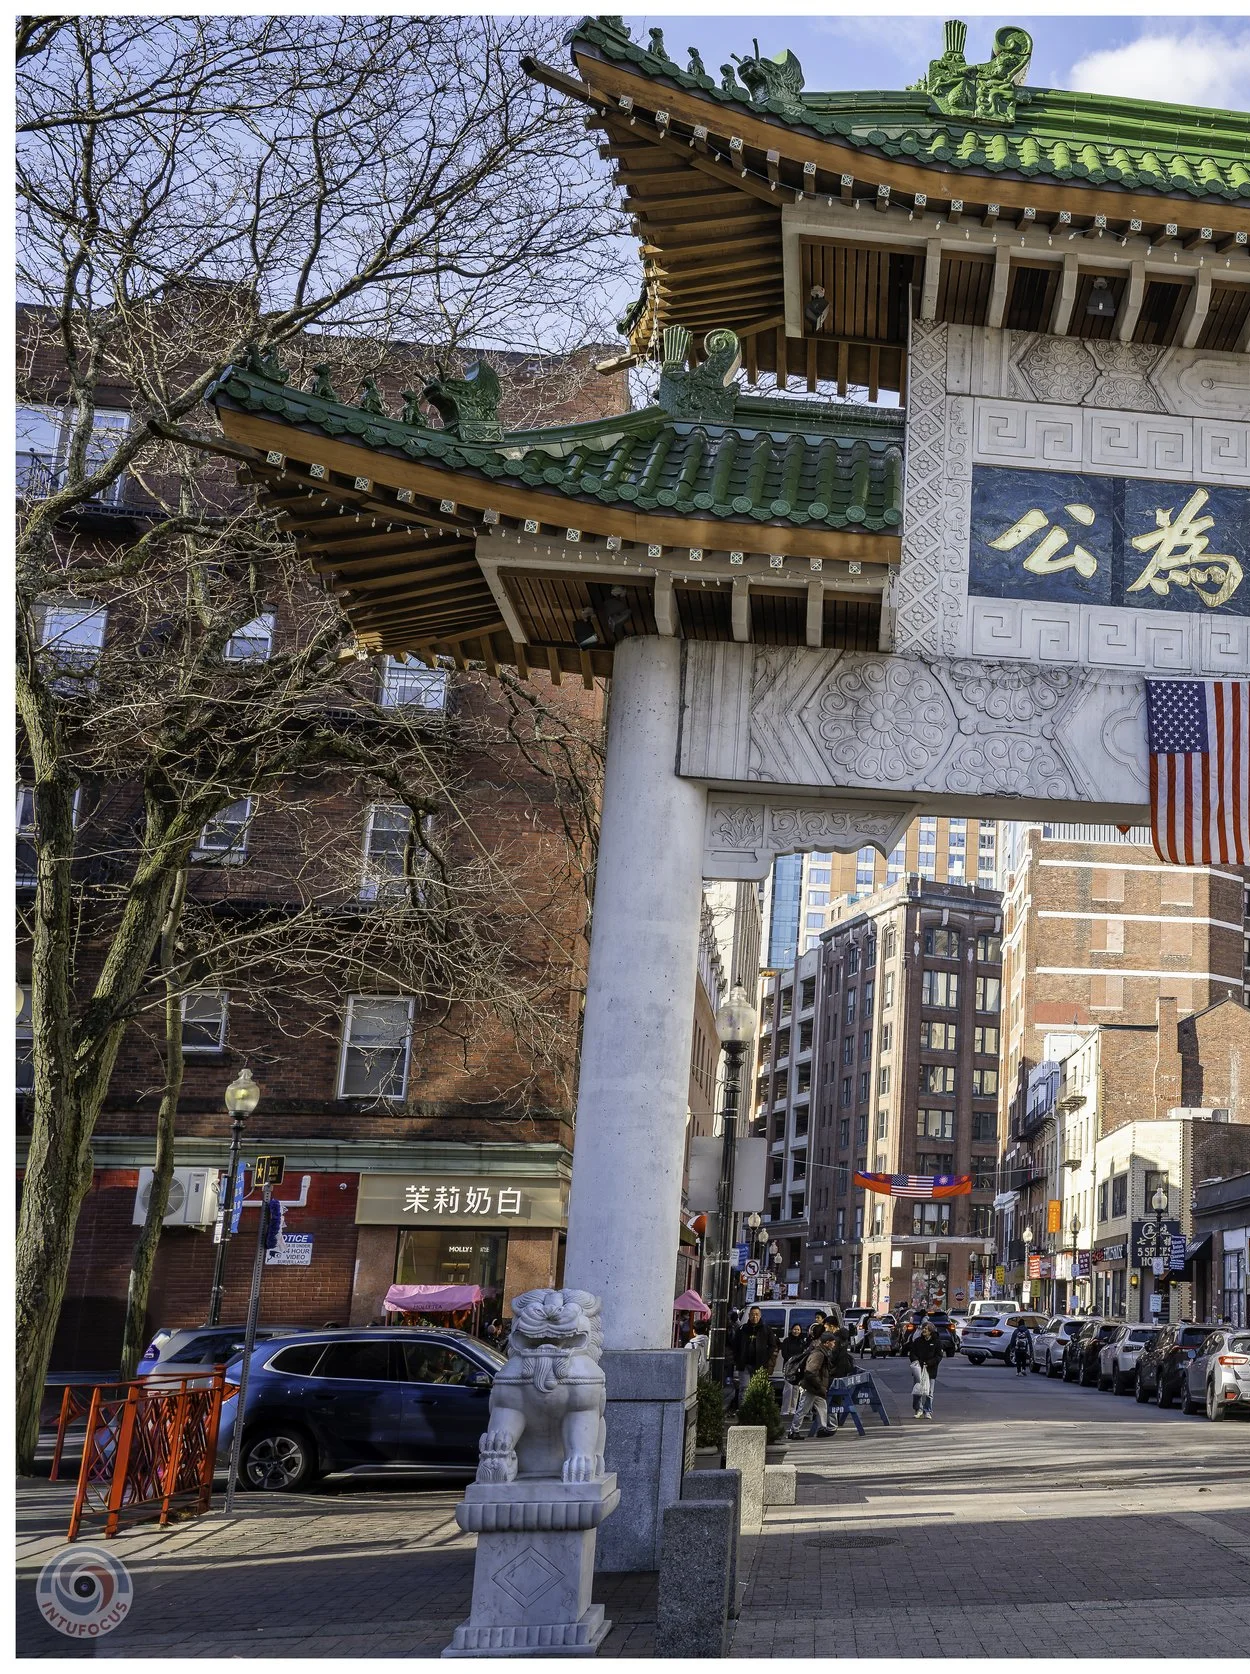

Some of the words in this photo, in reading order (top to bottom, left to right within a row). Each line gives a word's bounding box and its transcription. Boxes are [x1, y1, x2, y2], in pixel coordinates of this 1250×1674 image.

[402, 1185, 521, 1215] 茉莉奶白
[282, 1234, 309, 1243] OTICE
[1137, 1247, 1143, 1257] 5
[1144, 1247, 1170, 1257] SPIES
[1141, 1257, 1169, 1266] HOE
